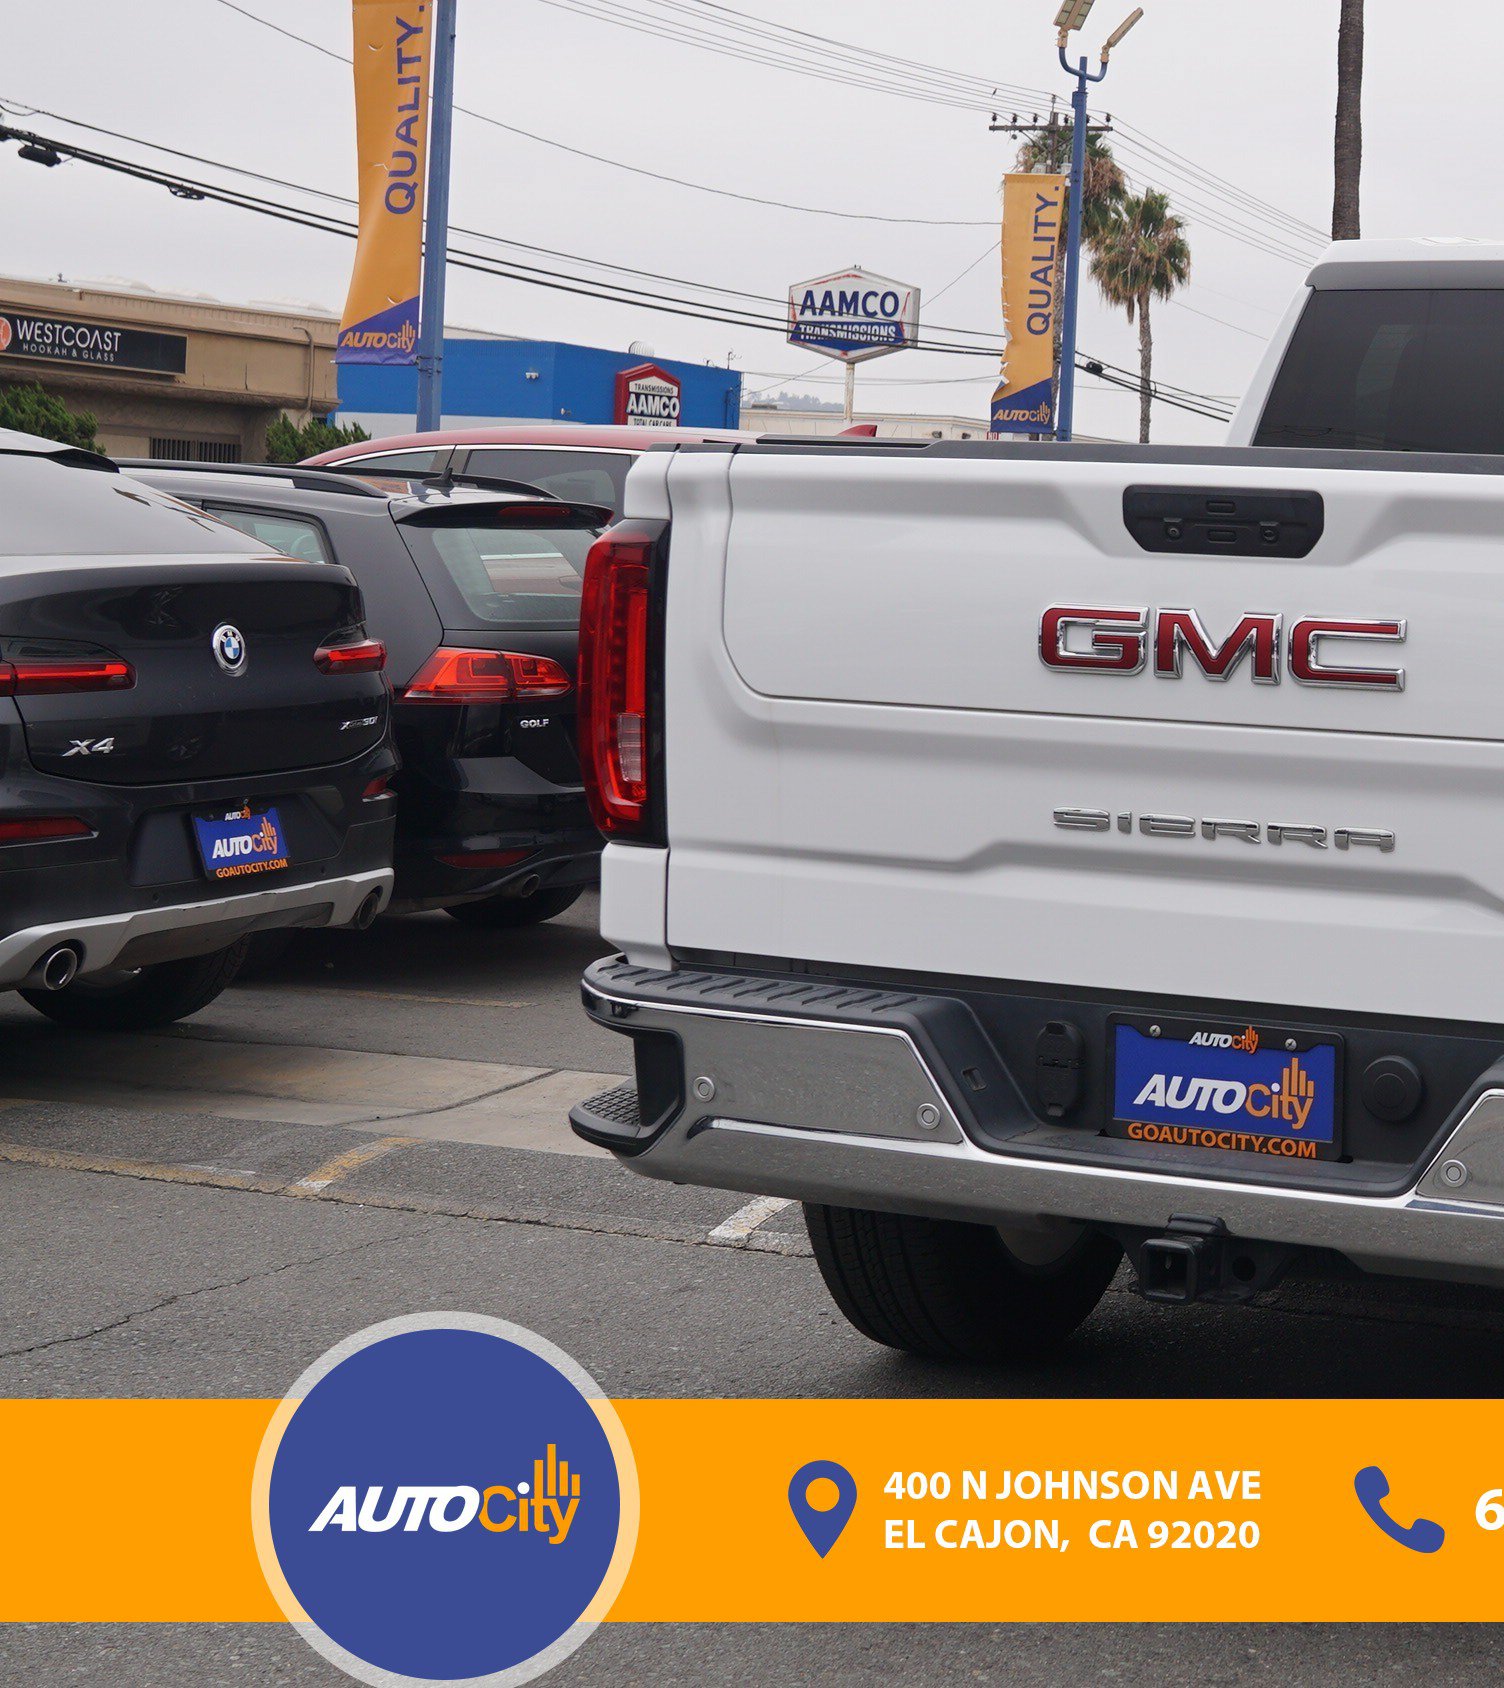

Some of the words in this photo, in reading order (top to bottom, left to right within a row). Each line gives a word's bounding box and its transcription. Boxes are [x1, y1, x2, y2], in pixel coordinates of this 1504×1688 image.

[799, 290, 900, 318] AAMCO
[16, 319, 122, 352] WESTCOAST
[799, 324, 896, 342] TRANSMISSIONS
[23, 343, 68, 357] HOOKAH
[71, 349, 78, 357] &
[82, 351, 115, 362] GLASS
[634, 384, 674, 394] TRANSMISSIONS
[626, 393, 680, 418] AAMCO
[1038, 601, 1407, 693] GMC
[520, 718, 549, 728] GOLF
[62, 737, 115, 756] X4
[1053, 807, 1396, 853] SIERRA
[216, 858, 288, 878] GOAUTOCITY.COM
[1127, 1123, 1318, 1159] GOAUTOCITY.COM
